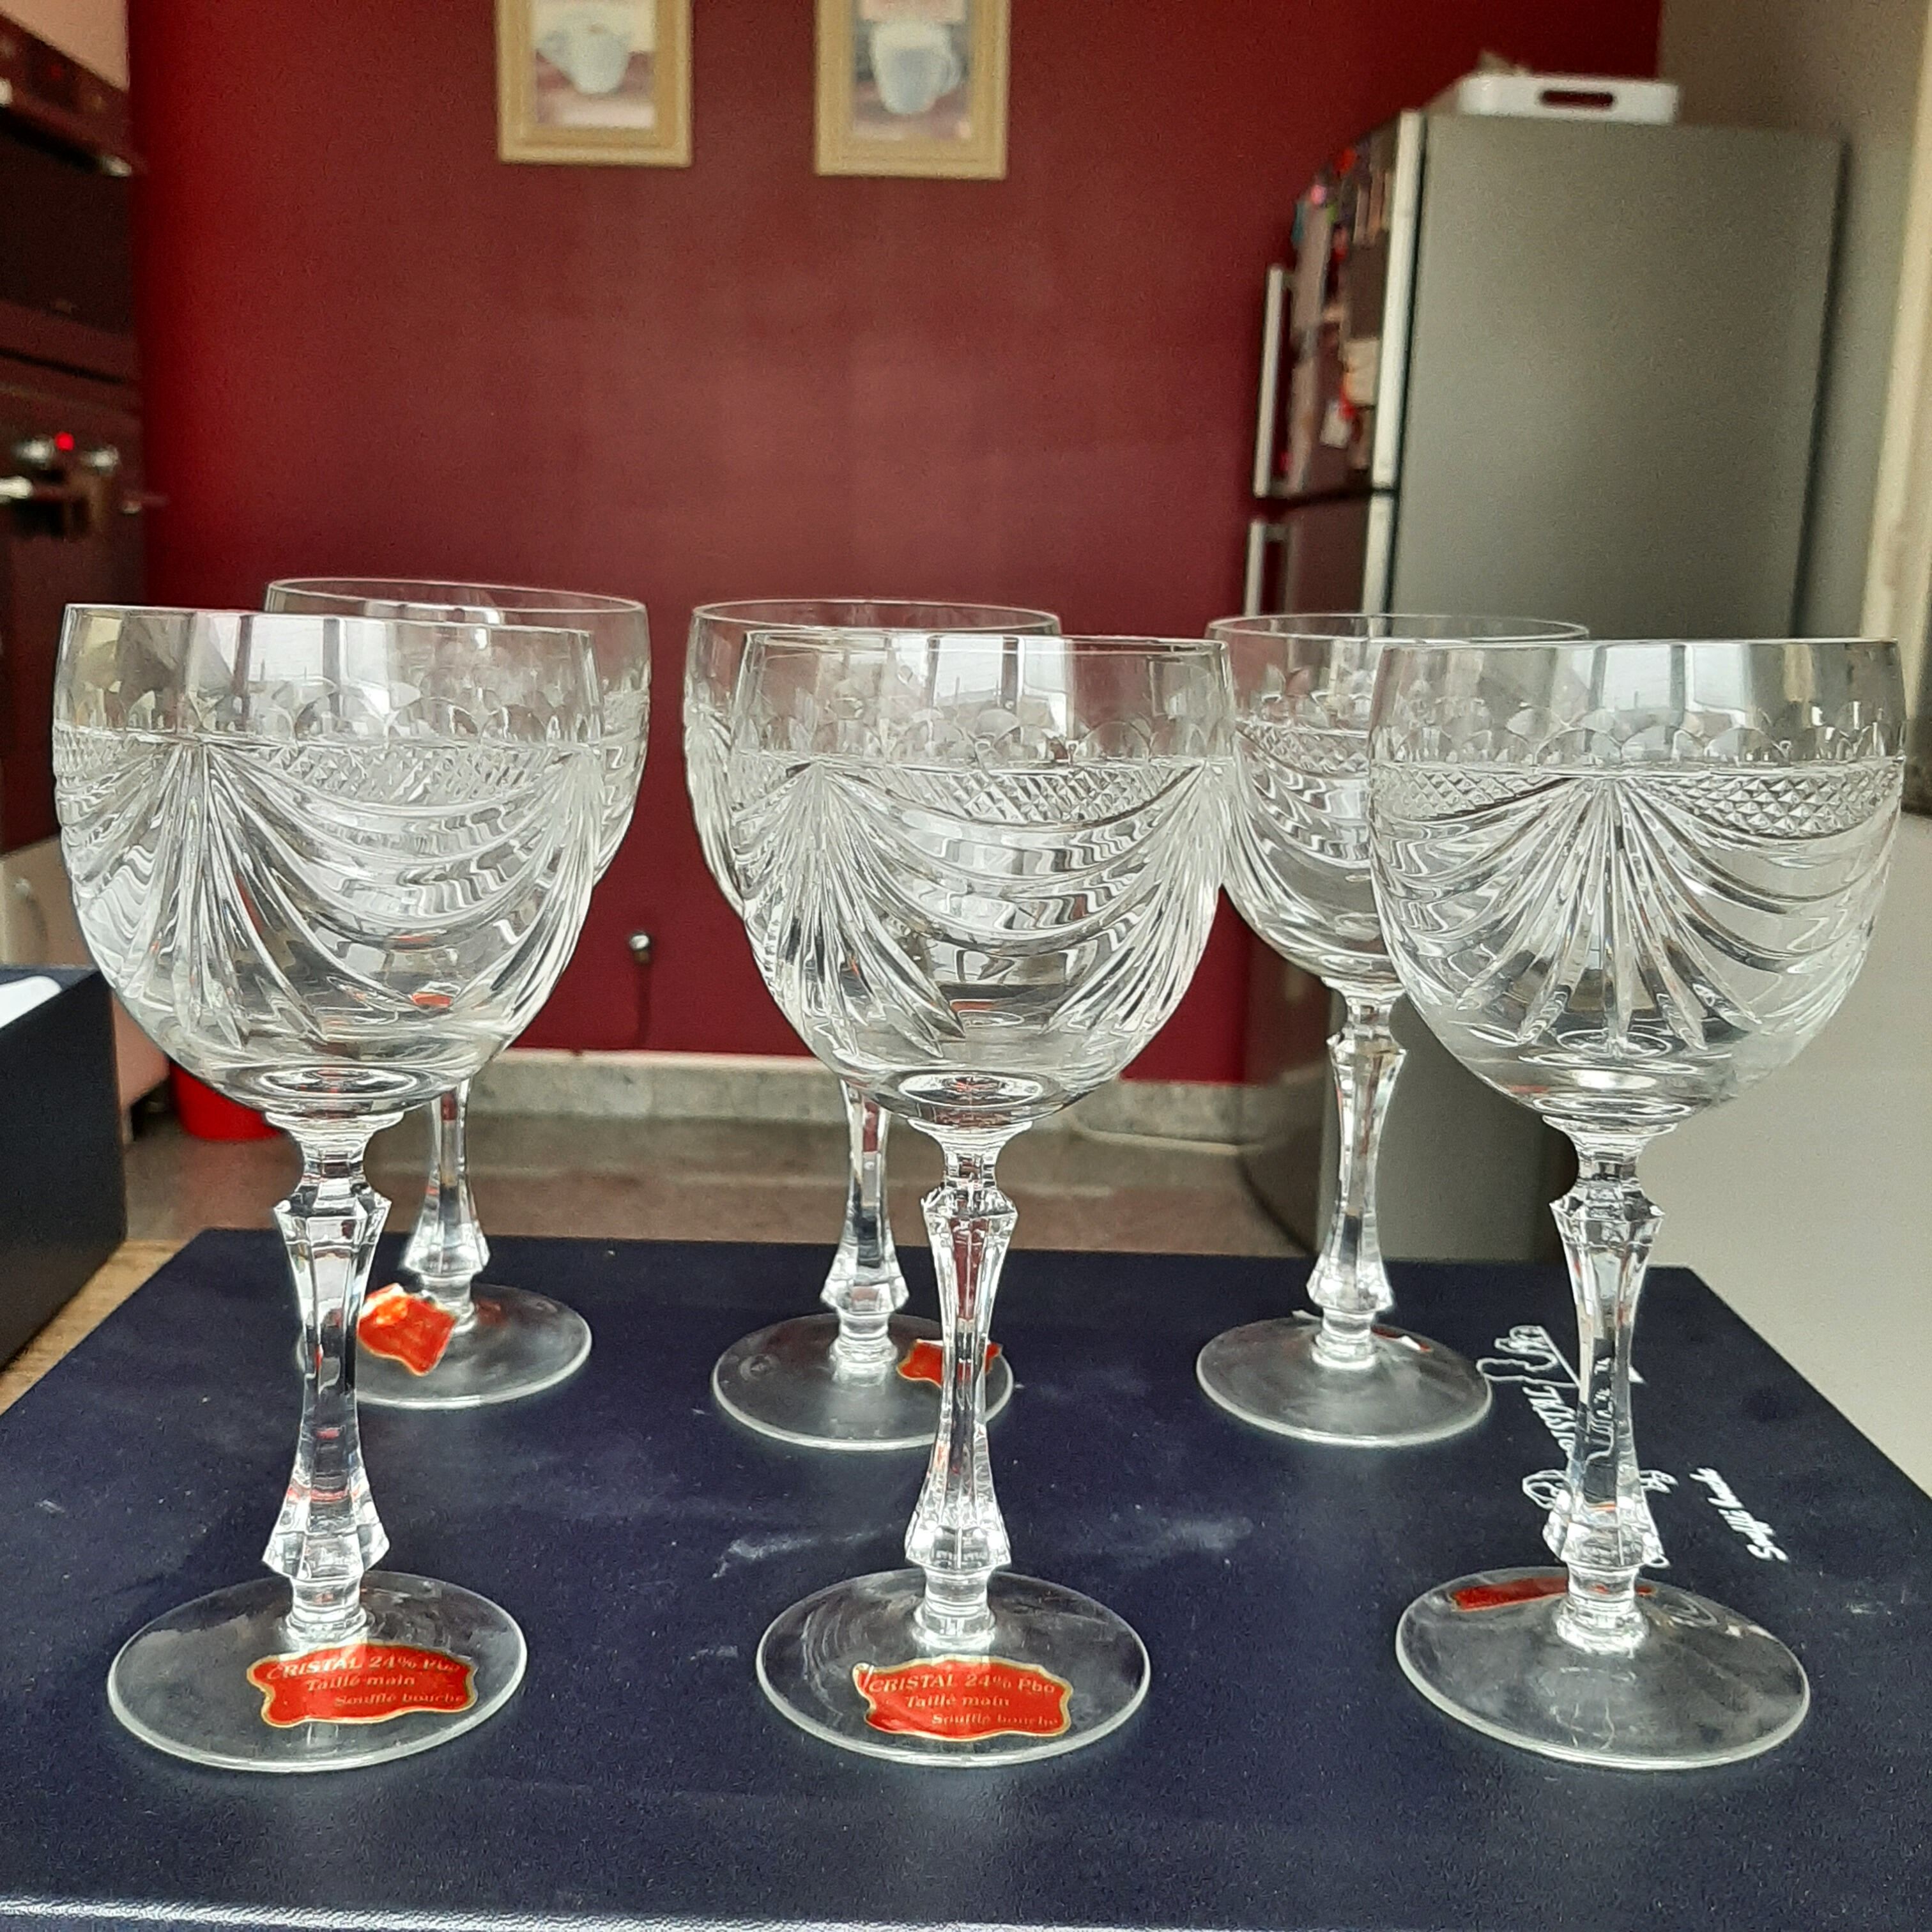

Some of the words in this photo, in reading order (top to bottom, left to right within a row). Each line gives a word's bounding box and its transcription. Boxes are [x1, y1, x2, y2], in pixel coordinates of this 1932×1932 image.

[266, 1656, 363, 1680] CRISTAL
[368, 1655, 417, 1669] 24%
[366, 1674, 415, 1686] main
[868, 1673, 958, 1693] CRISTAL
[964, 1673, 1012, 1689] 24%
[962, 1695, 1009, 1707] main
